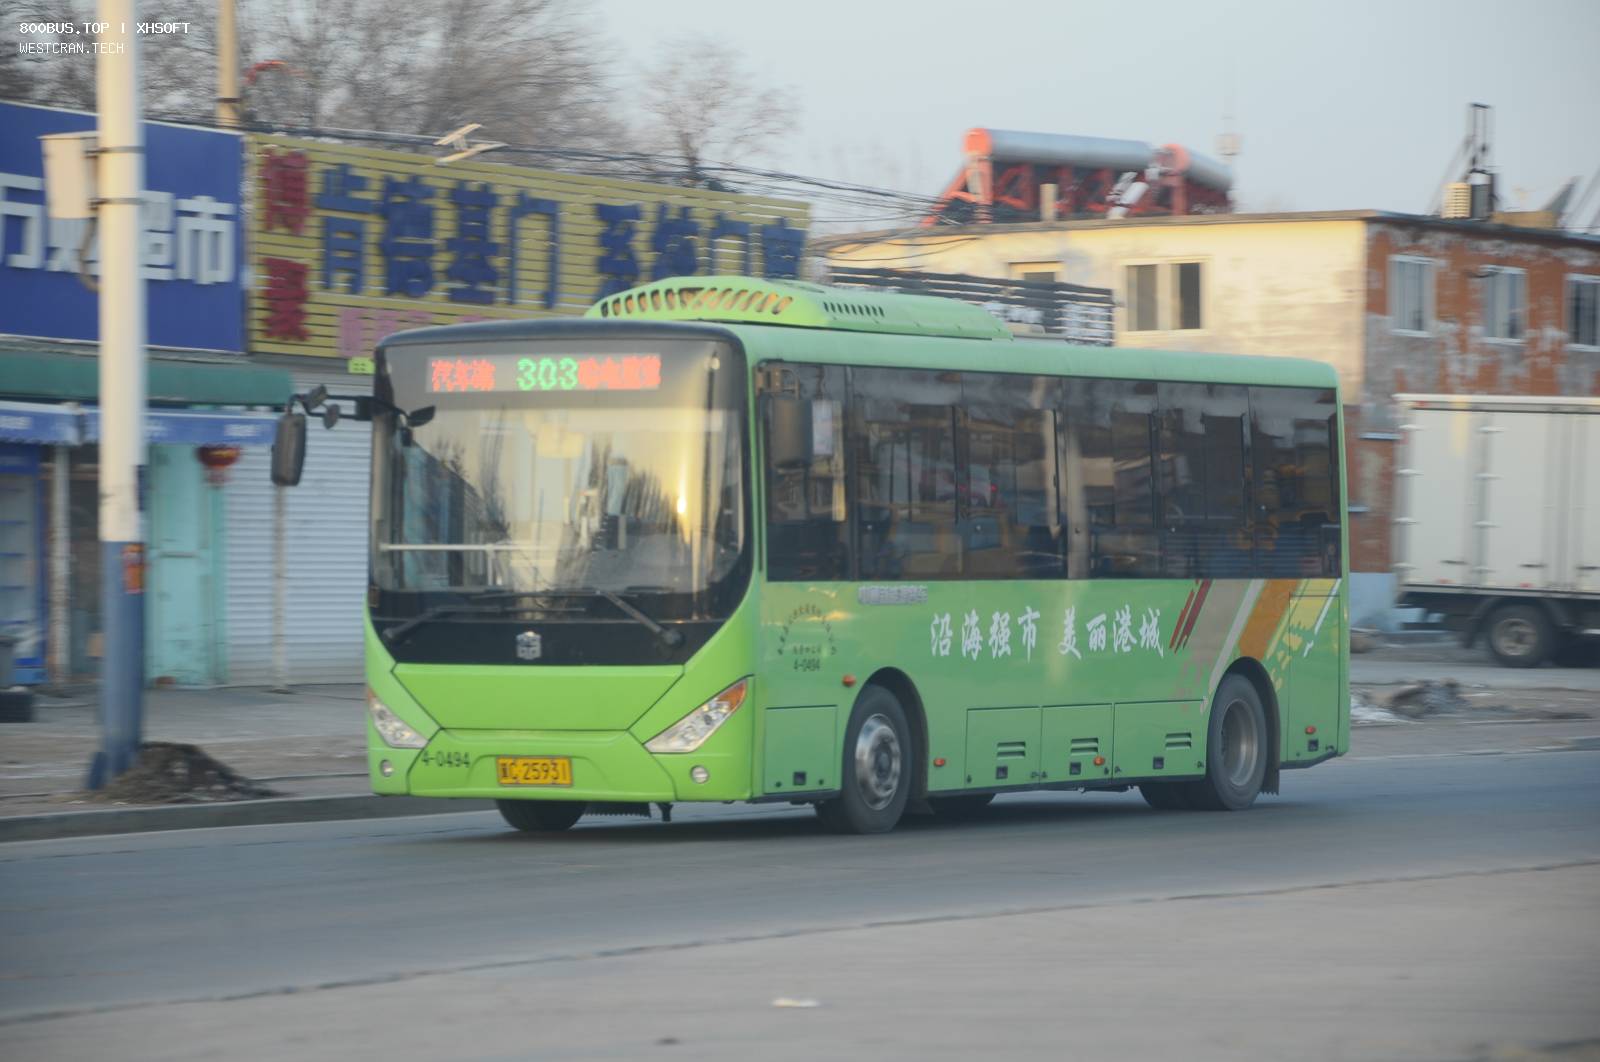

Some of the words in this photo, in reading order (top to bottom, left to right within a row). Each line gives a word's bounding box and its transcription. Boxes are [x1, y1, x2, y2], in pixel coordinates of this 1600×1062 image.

[516, 357, 579, 392] 303
[930, 606, 1041, 661] 沿海强市
[1058, 604, 1164, 660] 美丽港城
[421, 750, 471, 769] 4-0494
